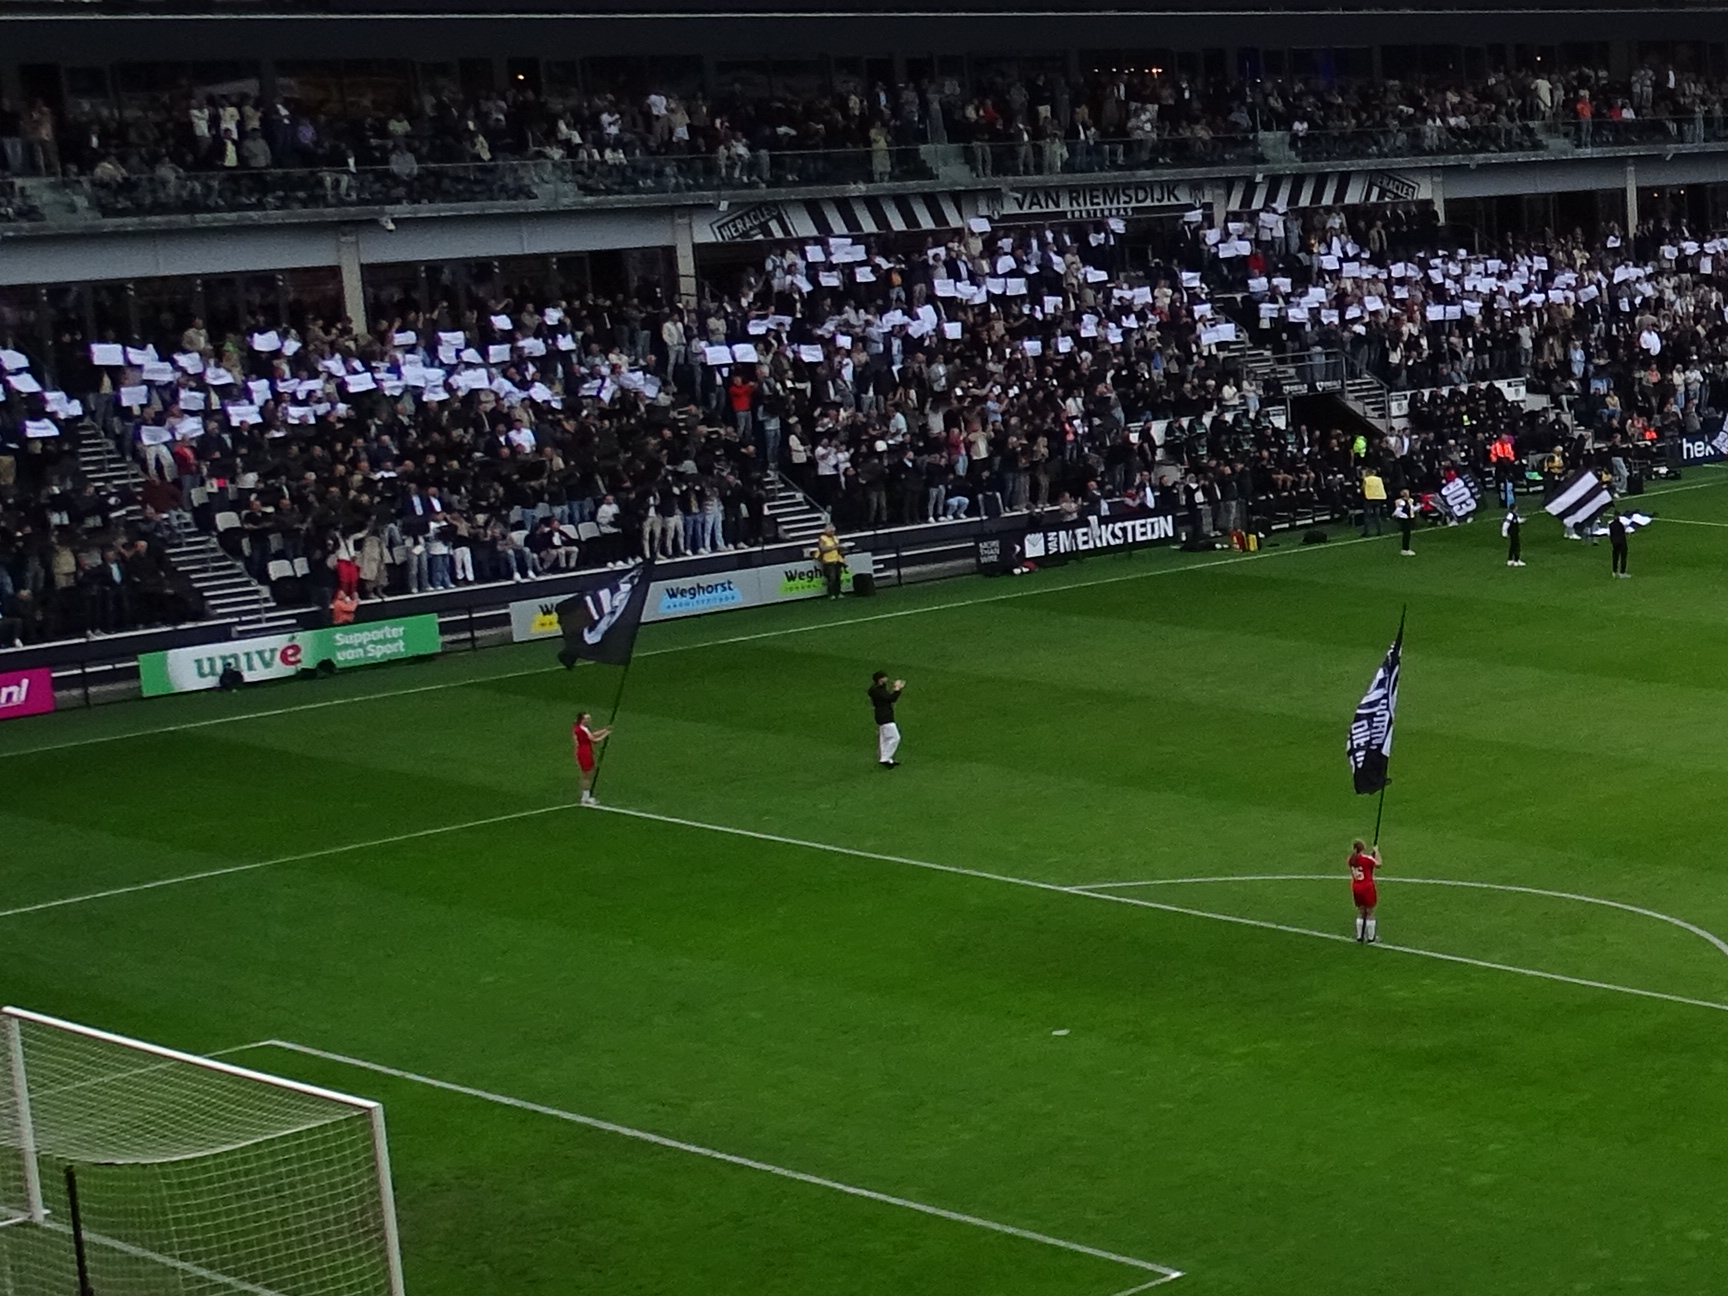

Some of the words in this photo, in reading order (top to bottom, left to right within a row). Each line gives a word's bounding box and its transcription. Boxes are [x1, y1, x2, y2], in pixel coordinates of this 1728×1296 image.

[1014, 190, 1060, 210] VAN
[1069, 185, 1181, 207] RIEMSDIJK
[720, 203, 779, 240] HERACLES
[665, 579, 734, 601] Weghorst
[334, 625, 406, 648] Supporter
[194, 634, 302, 680] univé
[337, 645, 363, 661] van
[366, 641, 406, 661] Sport
